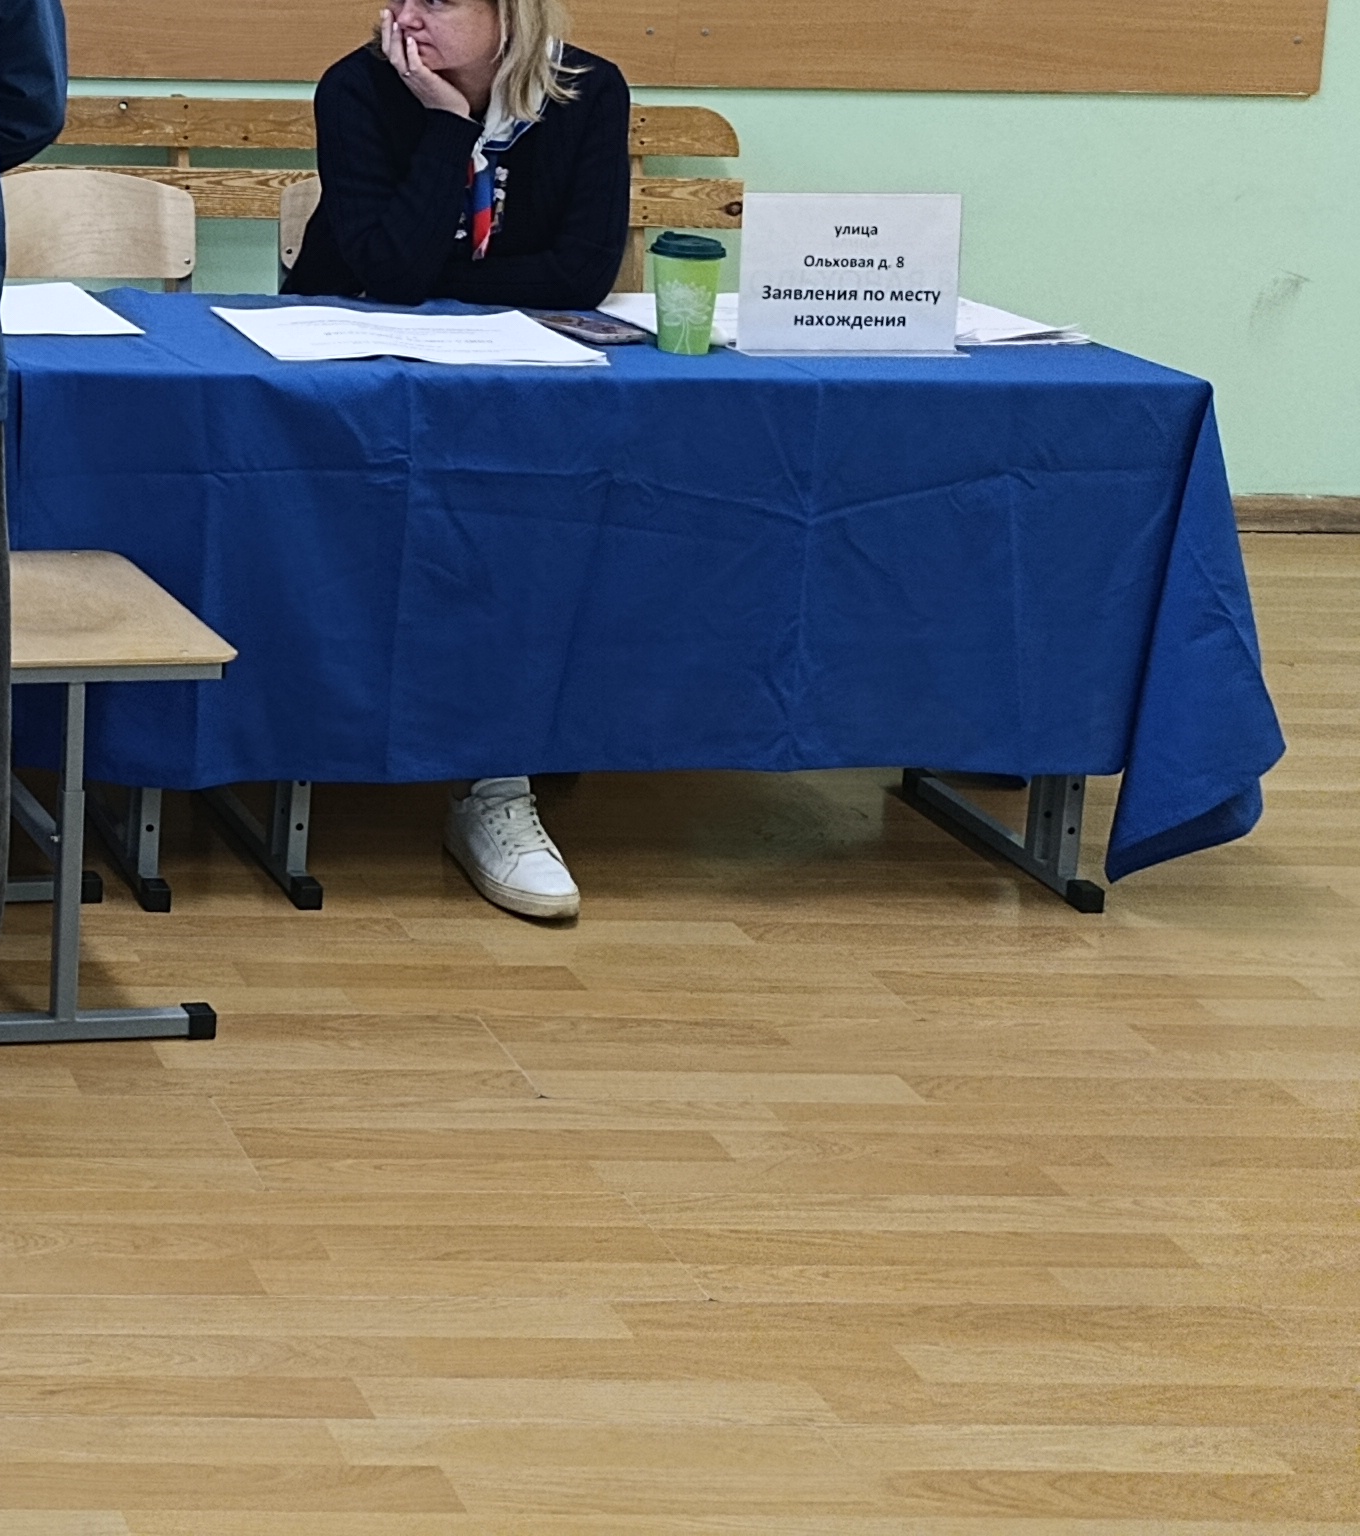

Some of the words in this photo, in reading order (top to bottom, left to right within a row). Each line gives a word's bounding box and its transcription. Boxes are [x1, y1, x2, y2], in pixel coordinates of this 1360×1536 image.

[833, 225, 879, 238] улица
[803, 254, 875, 269] Ольховая
[877, 257, 893, 271] д.
[895, 255, 905, 269] 8
[761, 284, 859, 302] Заявления
[862, 289, 886, 302] по
[889, 289, 942, 306] месту
[792, 313, 907, 331] нахождения
